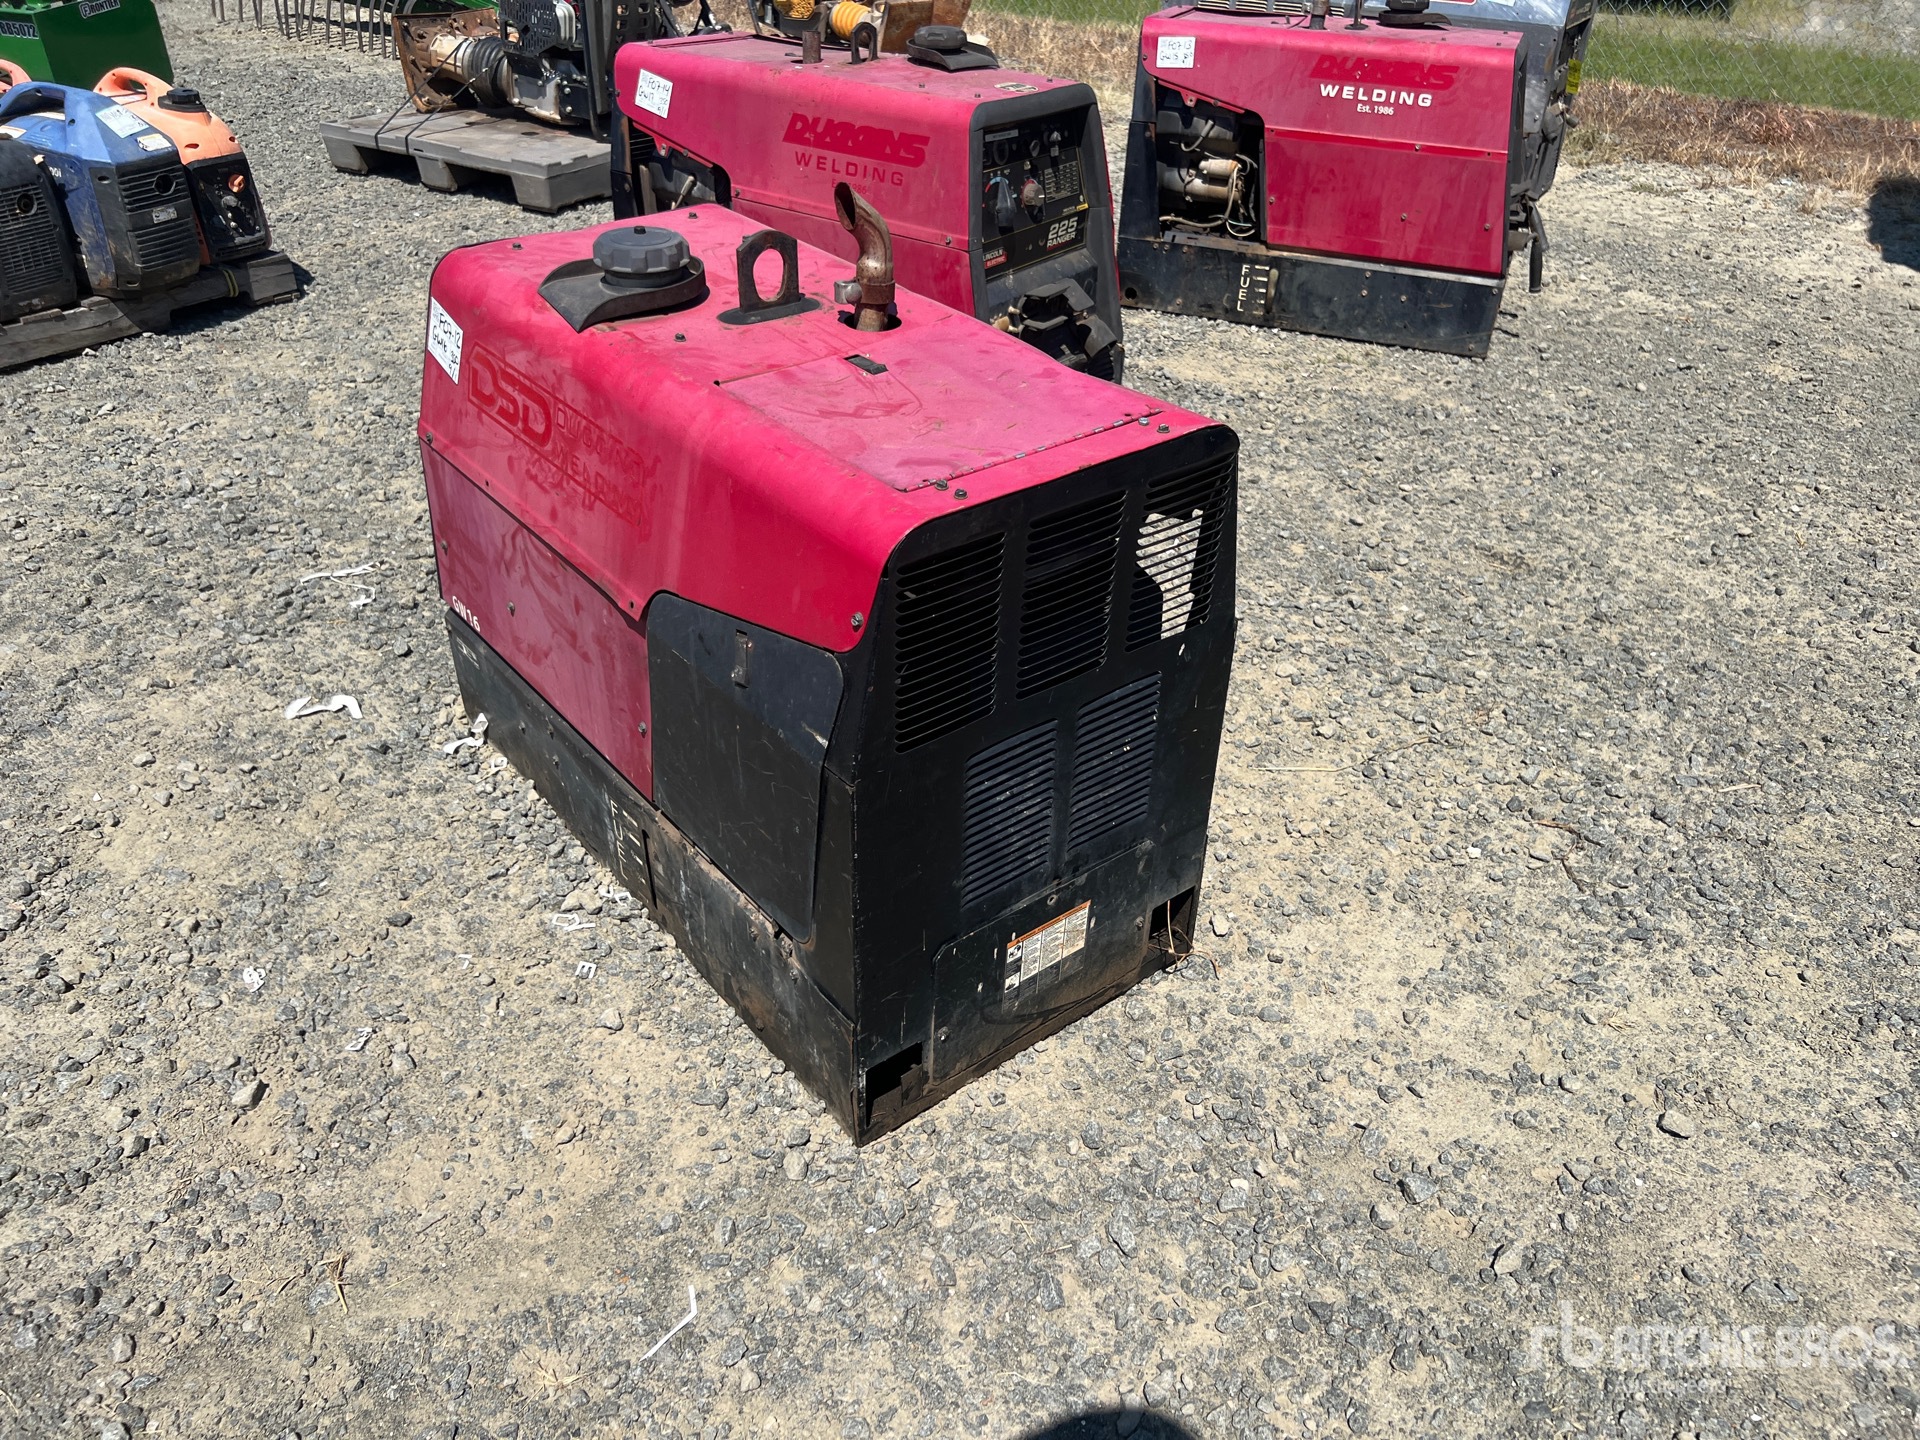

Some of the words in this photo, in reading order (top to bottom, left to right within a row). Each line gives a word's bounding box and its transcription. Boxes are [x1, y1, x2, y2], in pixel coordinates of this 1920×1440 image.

[1320, 83, 1433, 107] WELDING
[1356, 103, 1371, 114] Est.
[1374, 105, 1394, 116] 1986
[795, 151, 904, 187] WELDING
[1046, 231, 1077, 249] RANGER
[1048, 216, 1079, 240] 225
[1237, 264, 1251, 312] FUEL
[452, 595, 481, 633] GW16
[610, 799, 629, 881] FUEL
